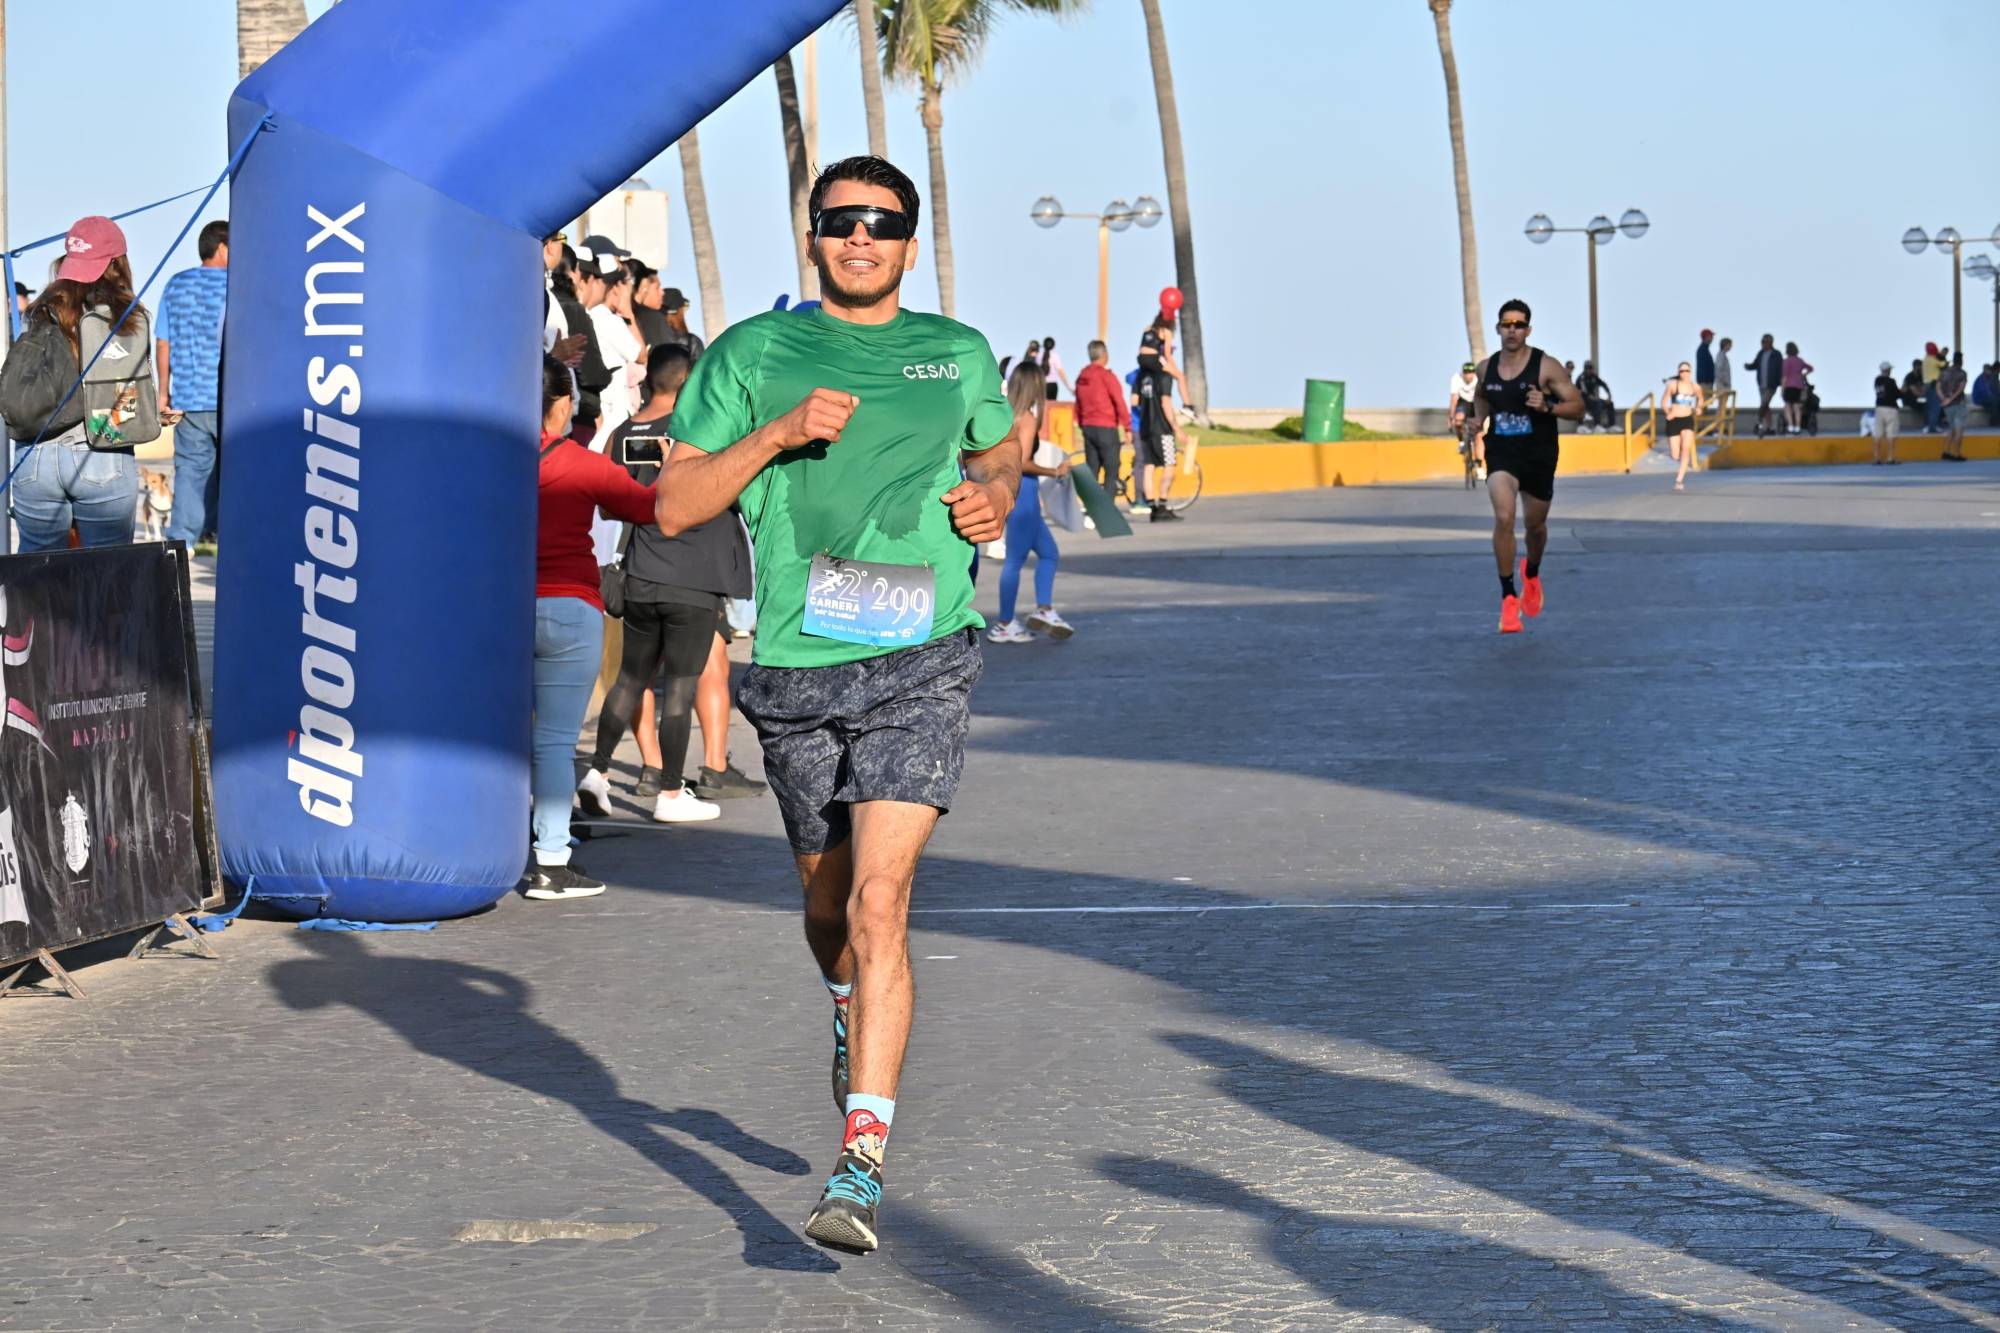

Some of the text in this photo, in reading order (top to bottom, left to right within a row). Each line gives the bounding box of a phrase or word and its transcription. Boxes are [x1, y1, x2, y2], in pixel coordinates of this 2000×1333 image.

[903, 363, 960, 379] CESAD
[809, 596, 861, 614] CARRERA
[871, 577, 930, 627] 299
